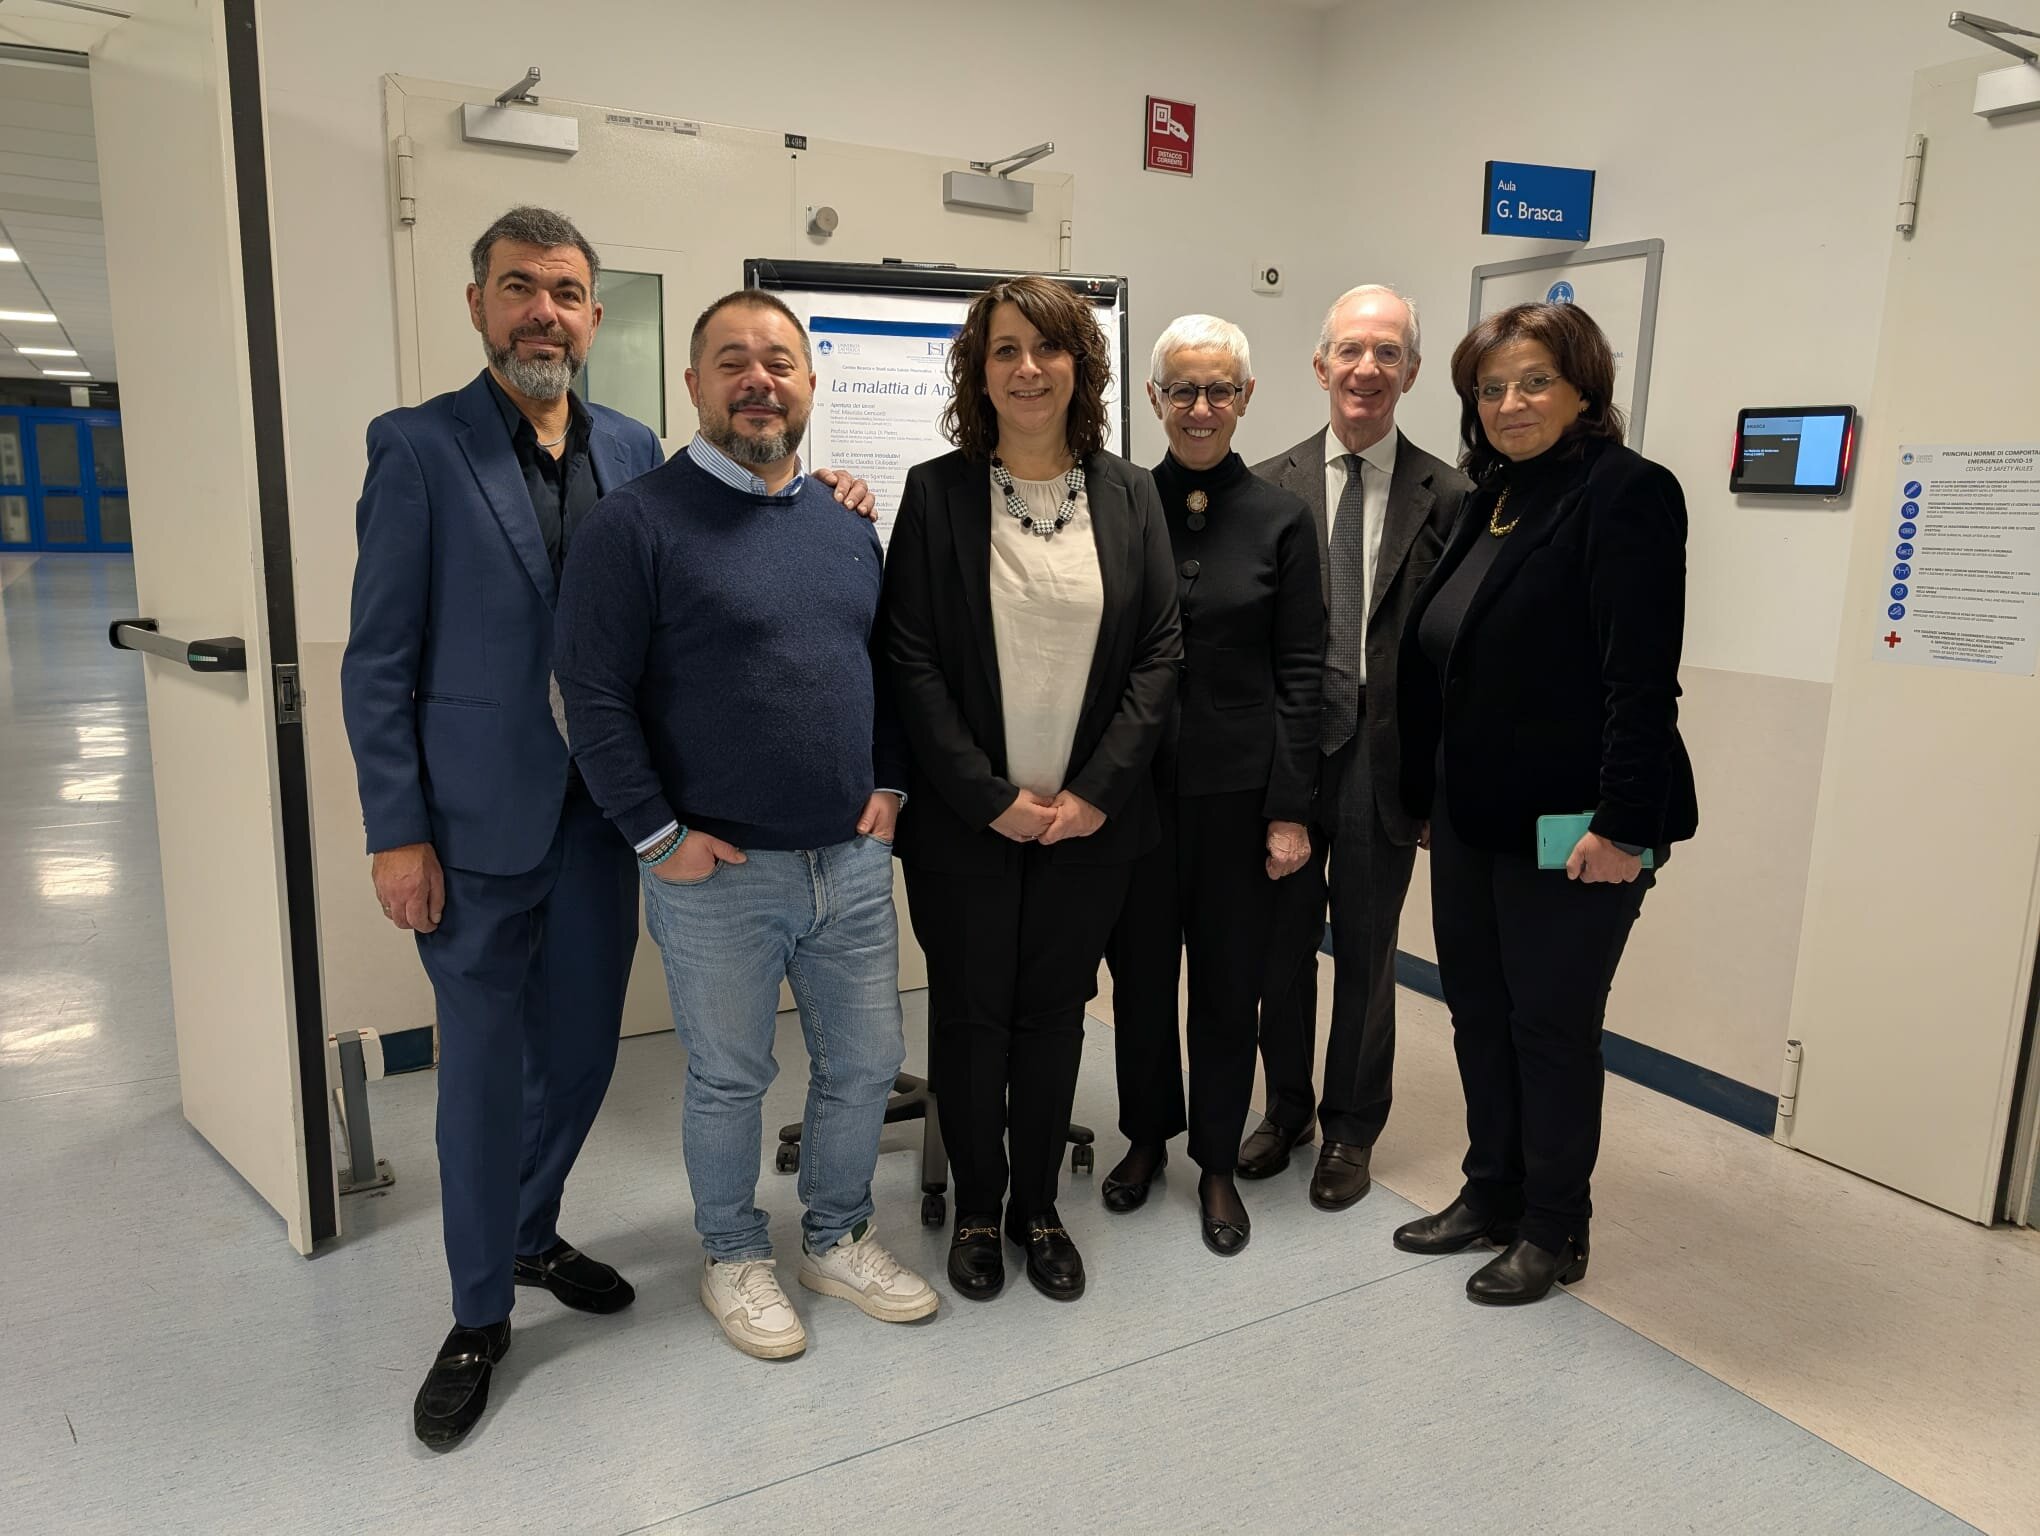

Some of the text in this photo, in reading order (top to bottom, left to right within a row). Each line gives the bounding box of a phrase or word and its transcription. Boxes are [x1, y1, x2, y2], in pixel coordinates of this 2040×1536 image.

[1158, 150, 1183, 160] DISTACCO
[1157, 157, 1183, 166] CORRENTE
[1497, 179, 1516, 191] Aula
[1496, 199, 1564, 222] G. Brasca
[831, 378, 847, 394] La
[852, 380, 909, 396] malattia
[914, 382, 927, 396] di
